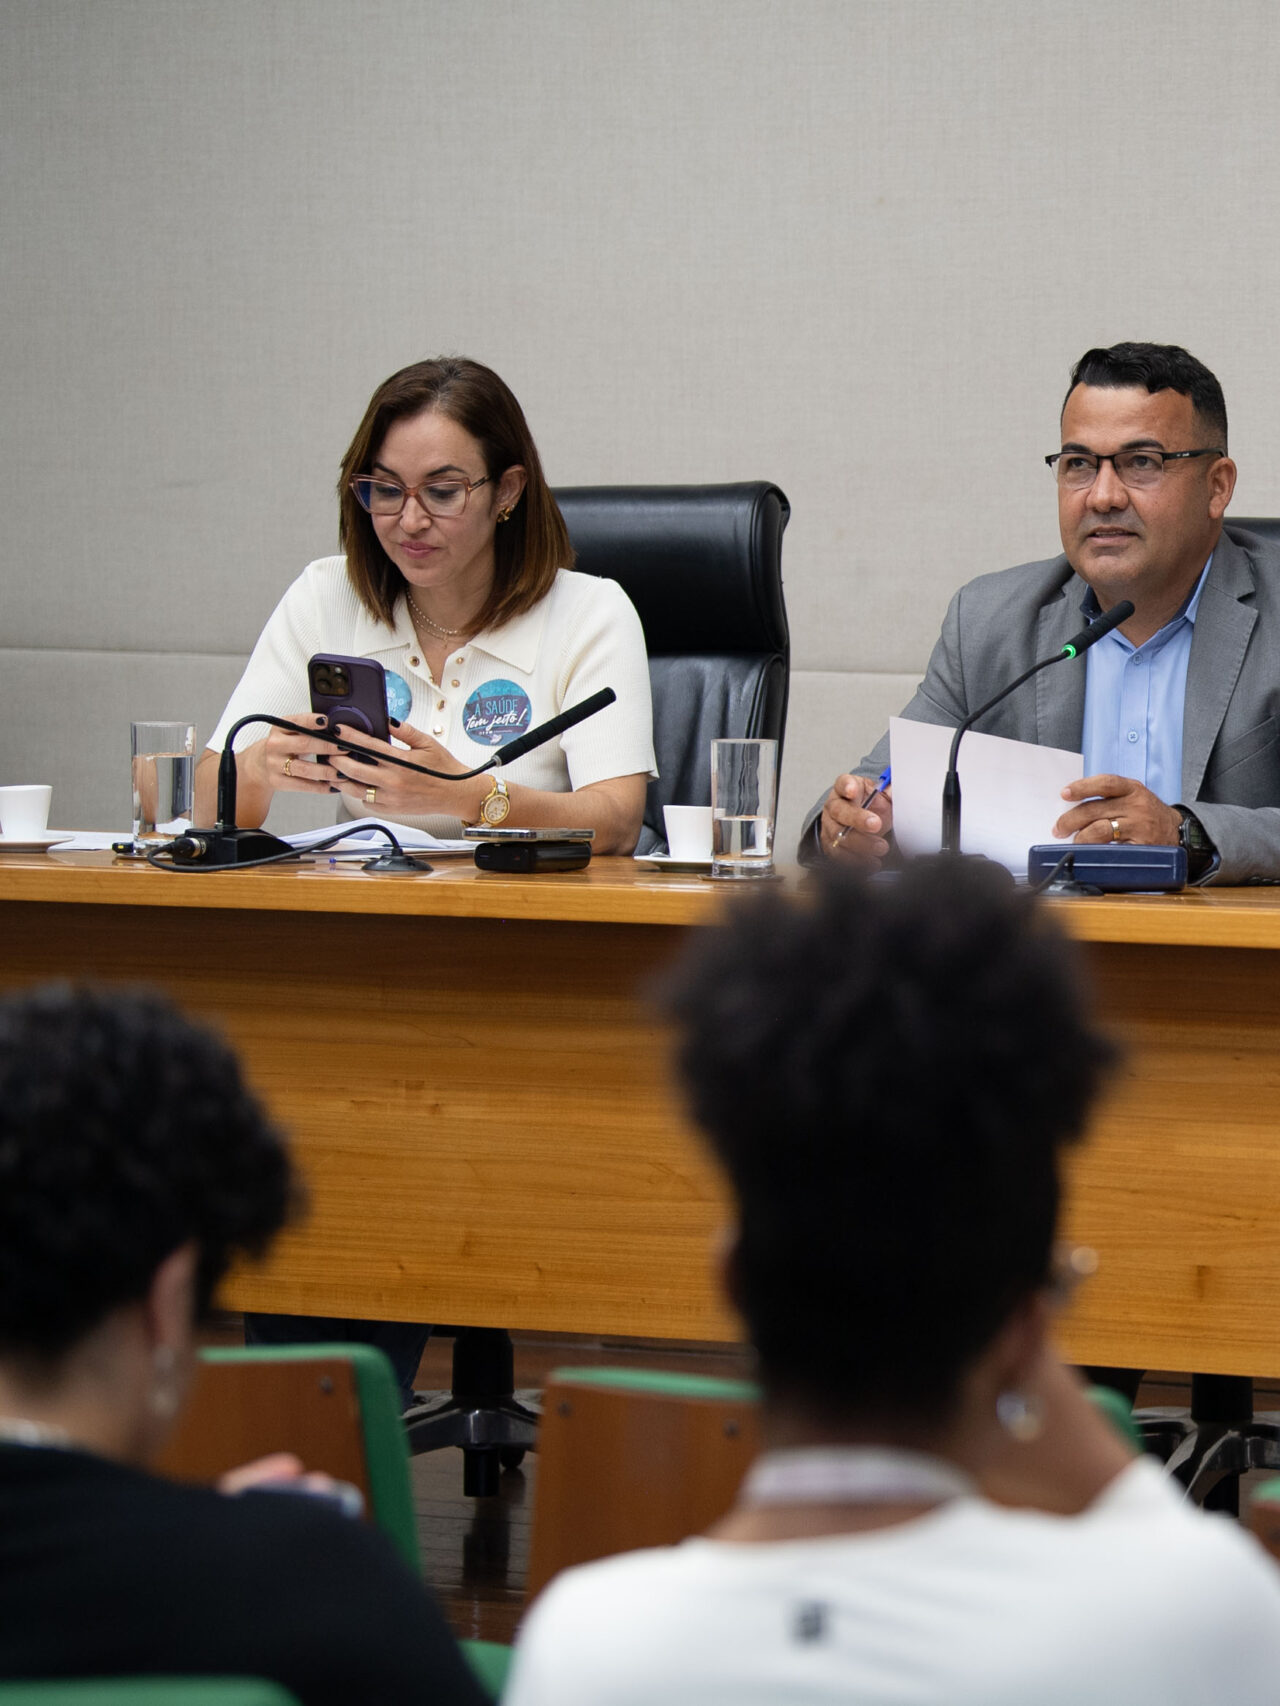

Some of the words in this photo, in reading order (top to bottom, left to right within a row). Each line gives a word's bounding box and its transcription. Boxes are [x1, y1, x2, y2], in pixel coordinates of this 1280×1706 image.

[474, 703, 481, 717] A
[485, 697, 518, 716] SAÚDE
[466, 714, 489, 731] tem
[486, 708, 528, 732] jeito!
